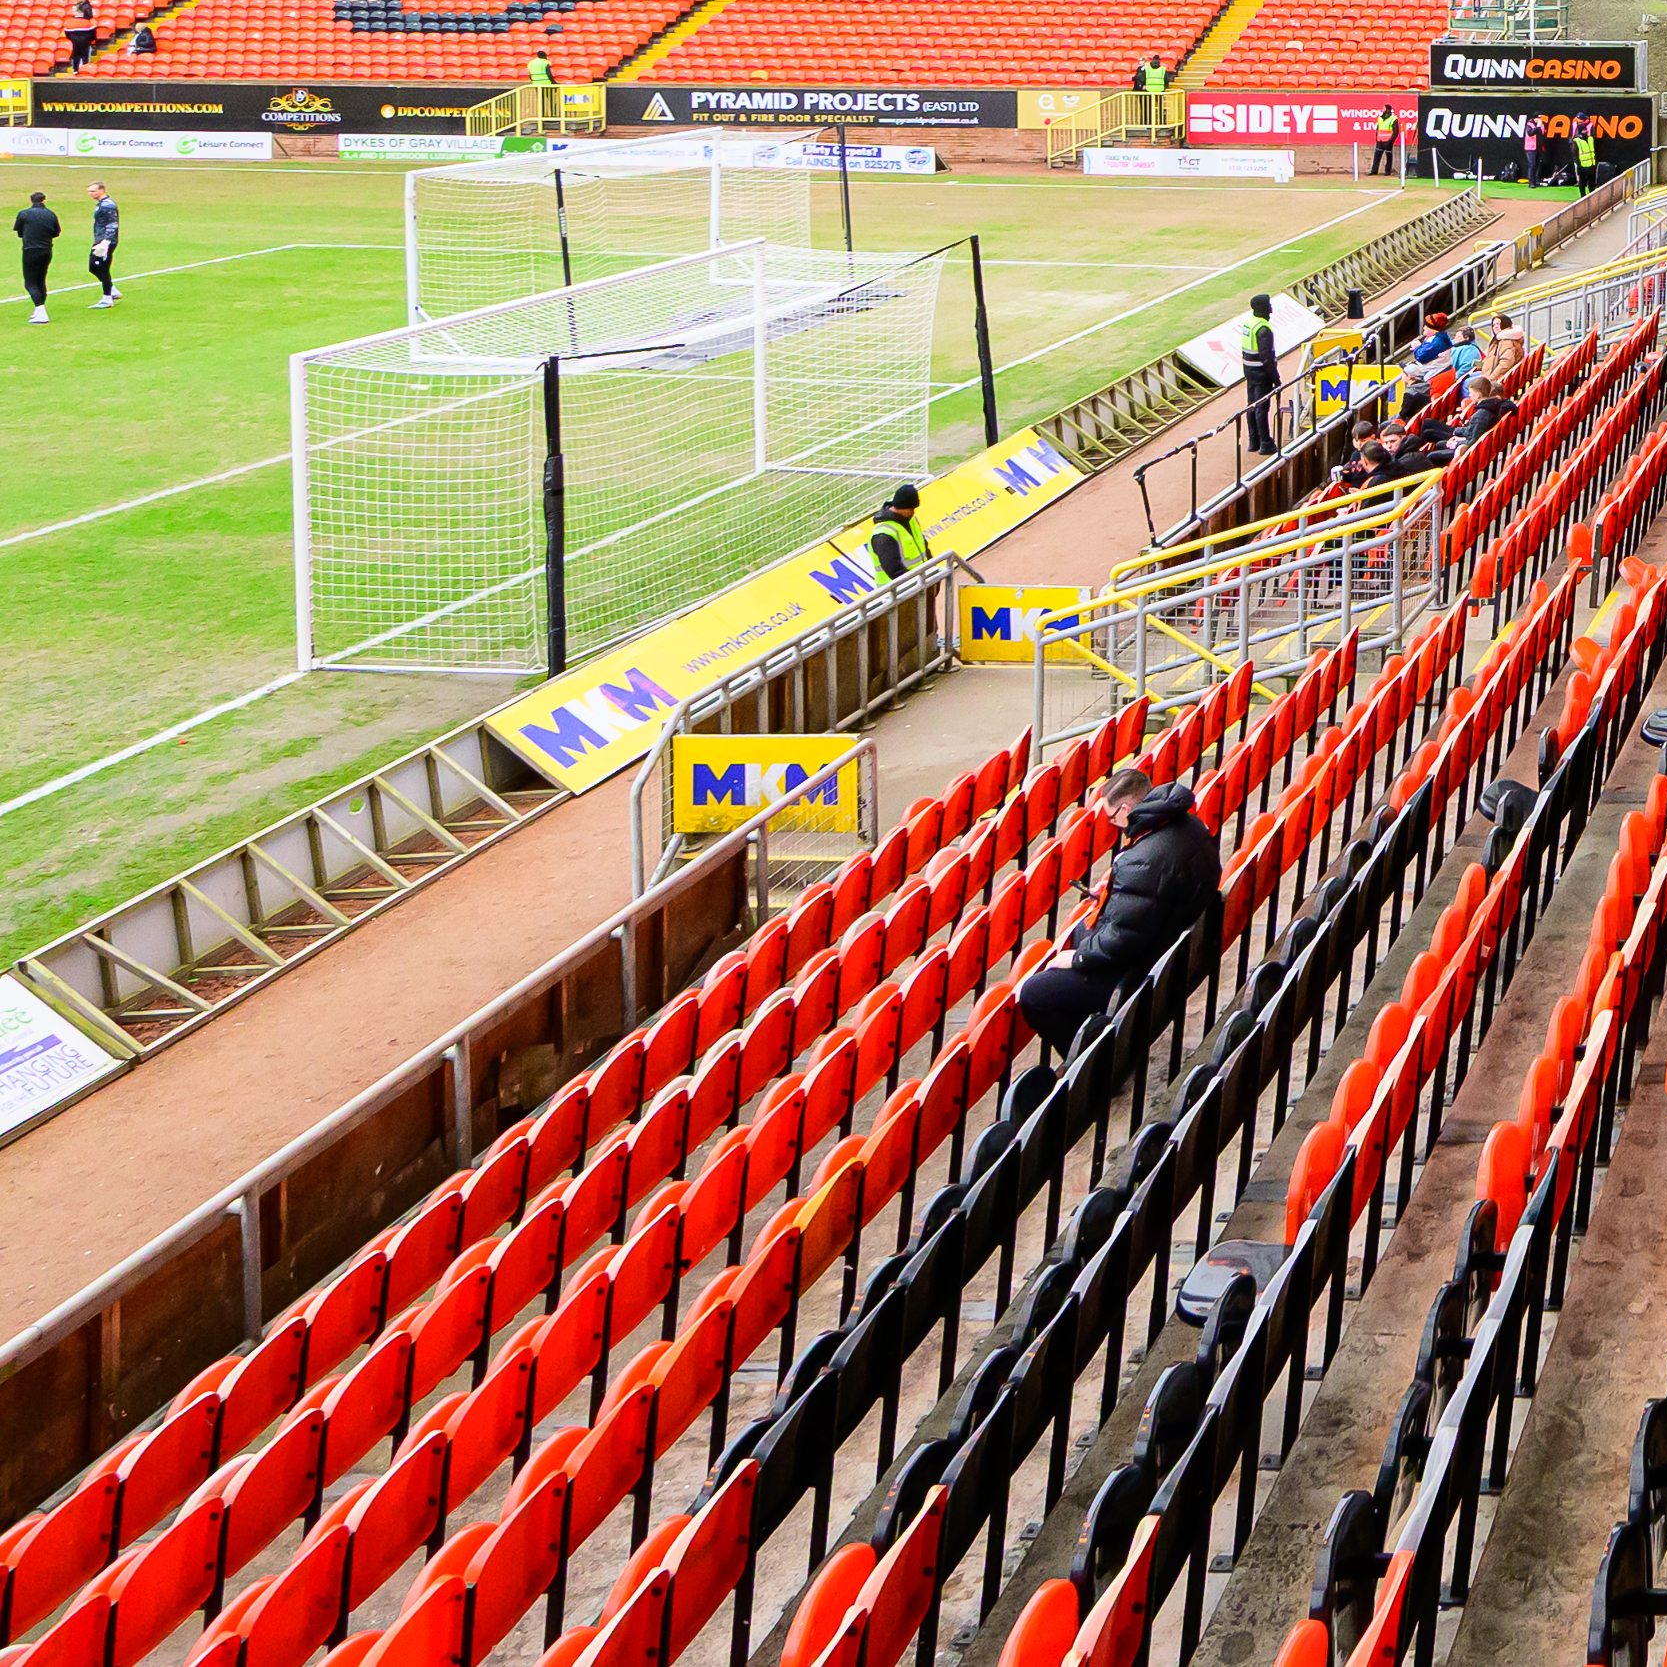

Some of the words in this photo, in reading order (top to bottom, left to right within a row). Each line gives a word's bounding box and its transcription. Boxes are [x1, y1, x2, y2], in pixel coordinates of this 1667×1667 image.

[1443, 53, 1622, 81] QUINNCASINO
[42, 102, 224, 114] WWW.DDCOMPETITIONS.COM
[691, 92, 799, 110] PYRAMID
[803, 92, 920, 112] PROJECTS
[922, 101, 957, 112] (EAST)
[958, 101, 980, 112] LTD
[261, 112, 342, 123] COMPETITIONS
[692, 113, 709, 122] FIT
[712, 113, 735, 122] OUT
[739, 114, 747, 122] &
[751, 114, 775, 123] FIRE
[778, 114, 811, 123] DOOR
[814, 114, 876, 123] SPECIALIST
[1213, 104, 1313, 133] SIDEY
[97, 138, 127, 147] Leisure
[129, 139, 163, 148] Connect
[198, 140, 228, 149] Leisure
[229, 141, 264, 149] Connect
[343, 137, 386, 148] DYKES
[390, 138, 406, 148] OF
[409, 138, 443, 149] GRAY
[446, 139, 497, 150] VILLAGE
[849, 160, 861, 168] on
[864, 159, 902, 170] 825275
[993, 438, 1070, 498] MKM
[680, 601, 808, 675] www.mkmbs.co.uk
[518, 666, 679, 770] MKM
[692, 762, 839, 807] MKM
[20, 1055, 94, 1097] FUTURE
